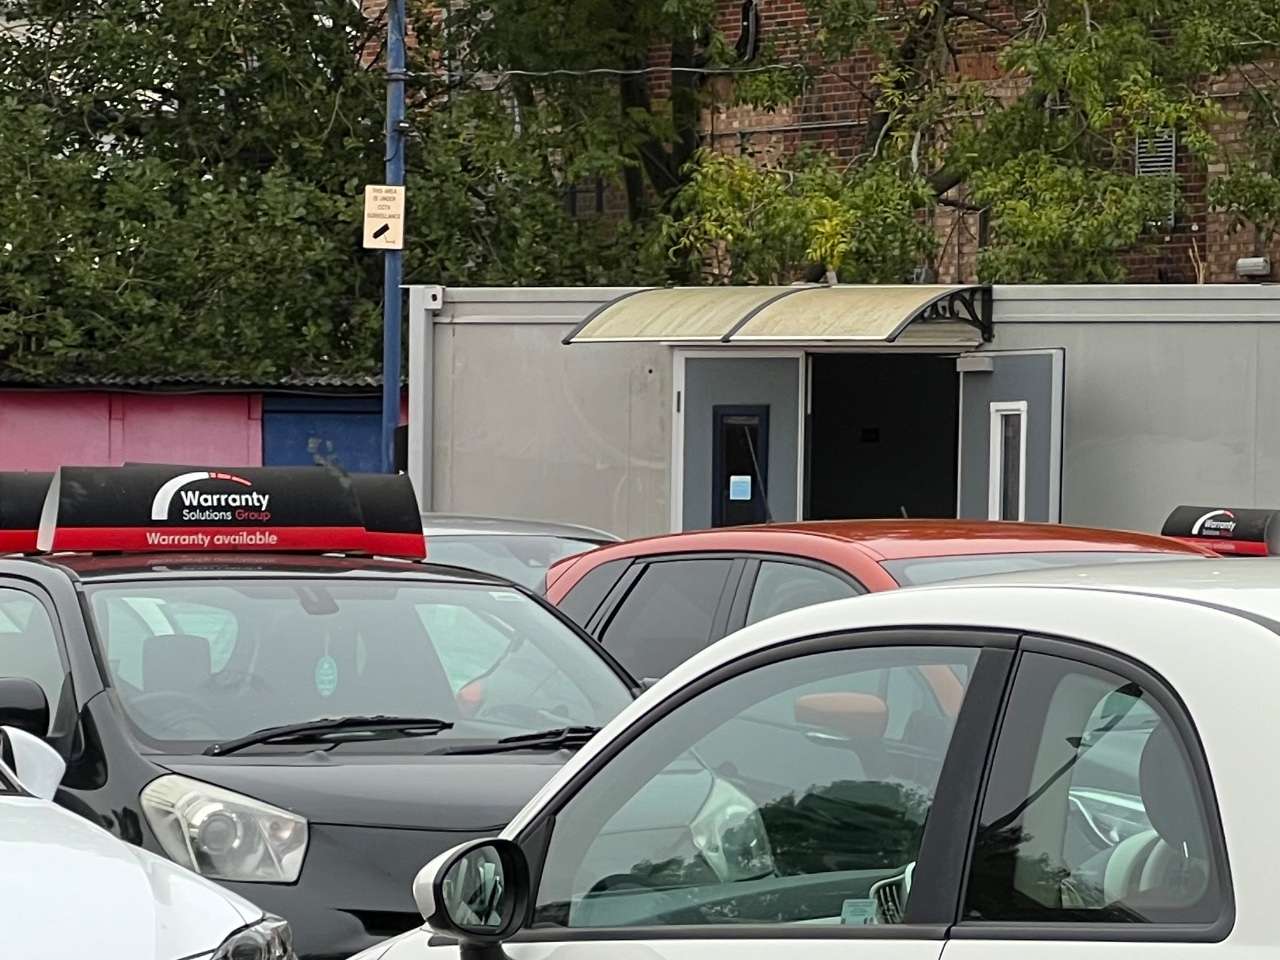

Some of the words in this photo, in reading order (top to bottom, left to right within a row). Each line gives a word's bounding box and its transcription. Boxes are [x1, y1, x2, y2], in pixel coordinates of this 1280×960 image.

[180, 490, 270, 511] Warranty
[182, 509, 232, 520] Solutions
[235, 510, 271, 522] Group
[1204, 519, 1236, 532] Warranty
[146, 532, 211, 547] Warranty
[213, 531, 278, 545] available
